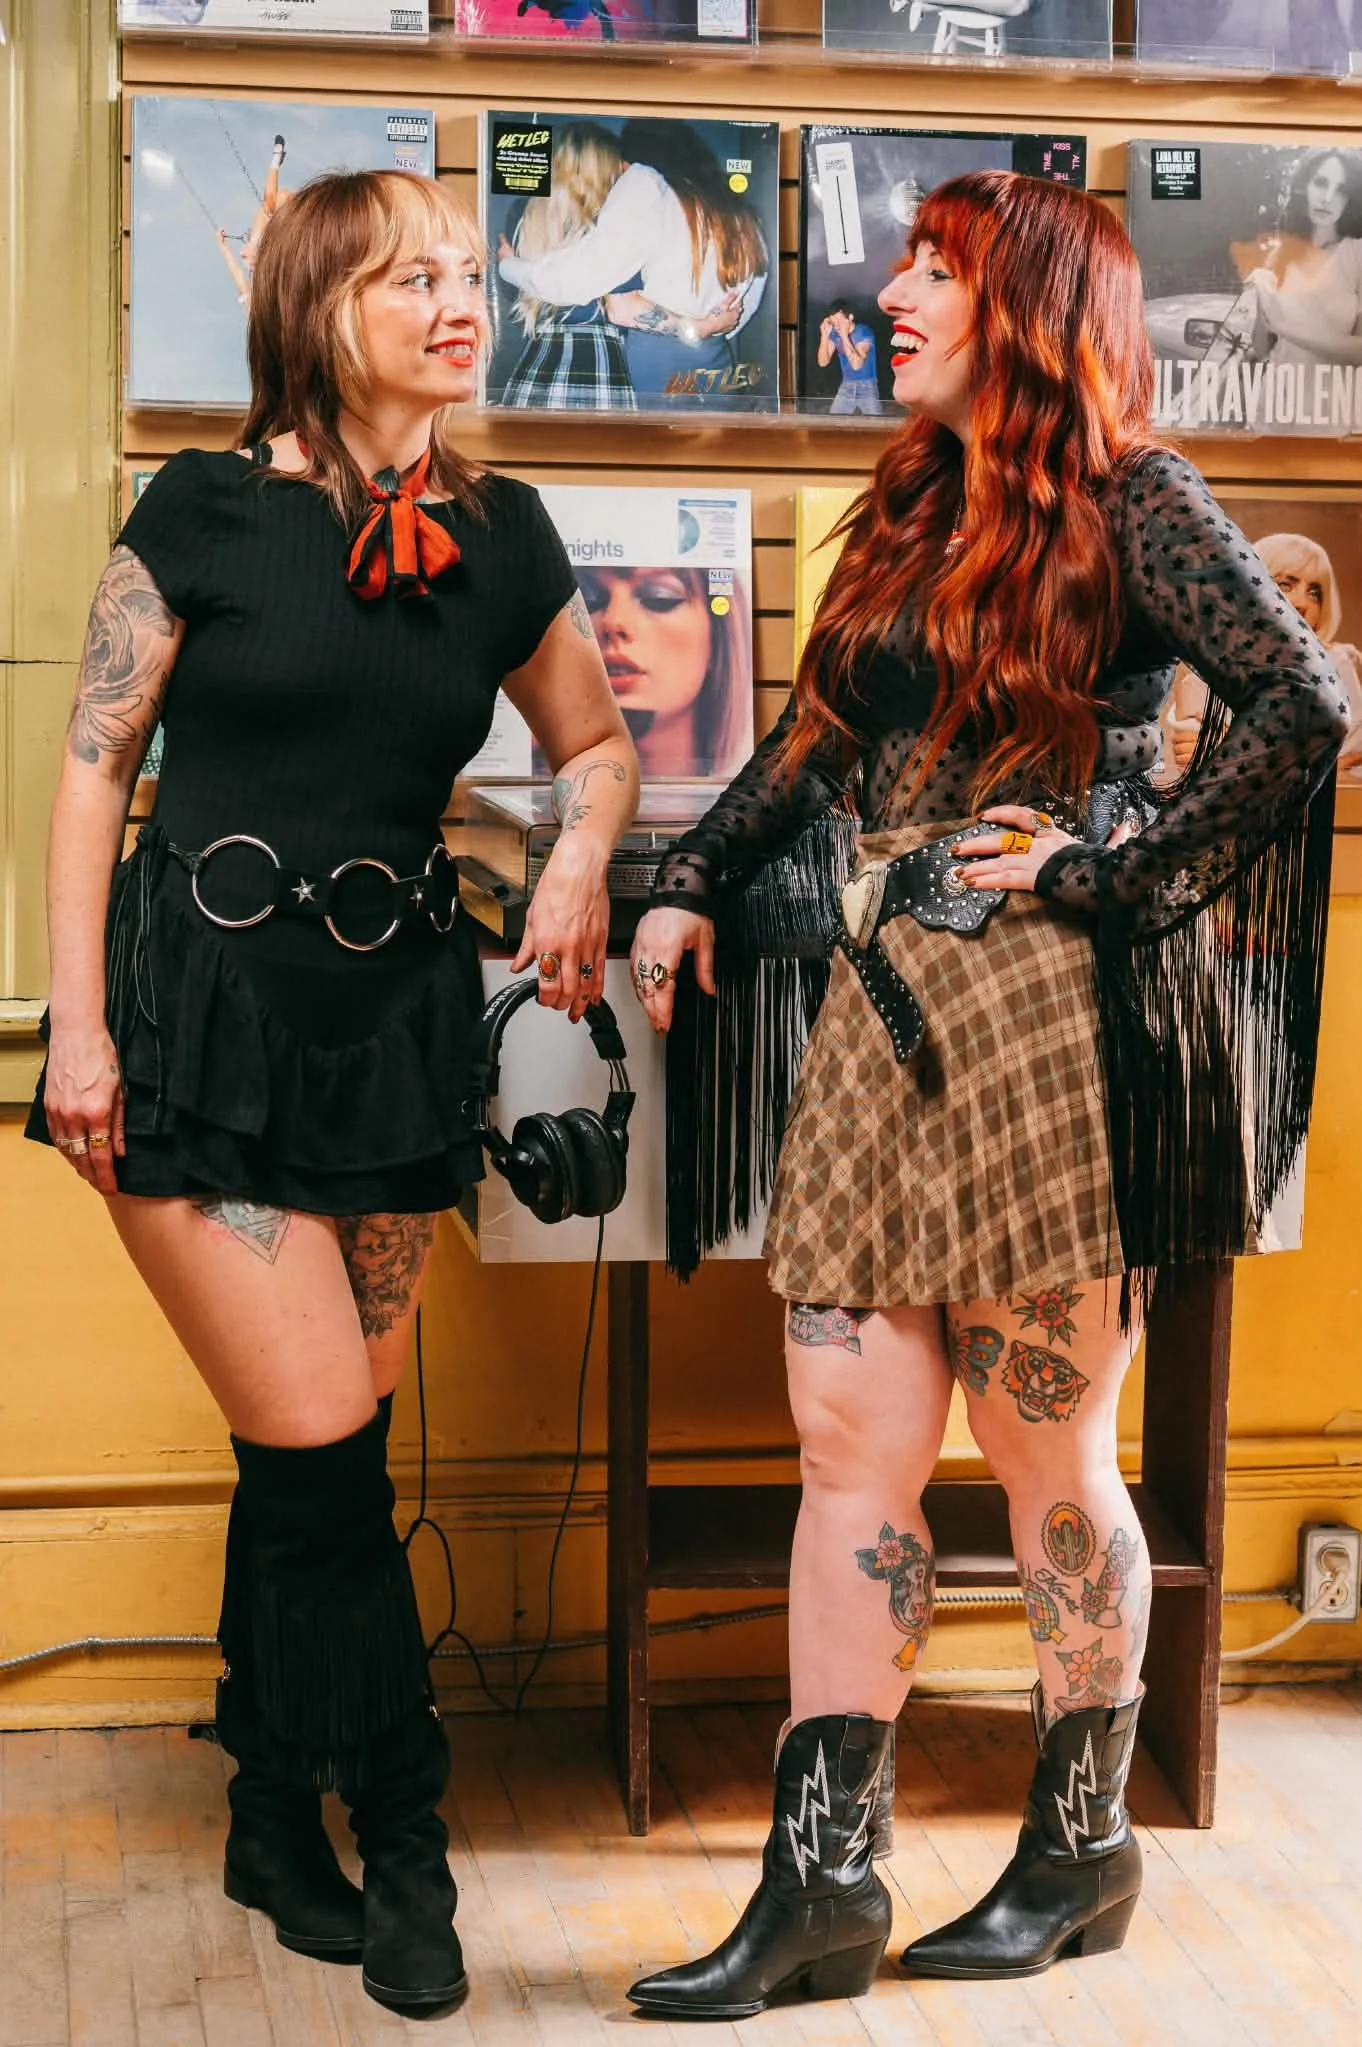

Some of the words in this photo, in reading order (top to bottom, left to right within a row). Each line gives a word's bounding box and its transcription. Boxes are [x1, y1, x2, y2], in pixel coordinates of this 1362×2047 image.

[1052, 142, 1071, 151] KISS
[395, 159, 417, 168] NEW
[728, 161, 750, 170] NEW
[1072, 154, 1081, 170] ALL
